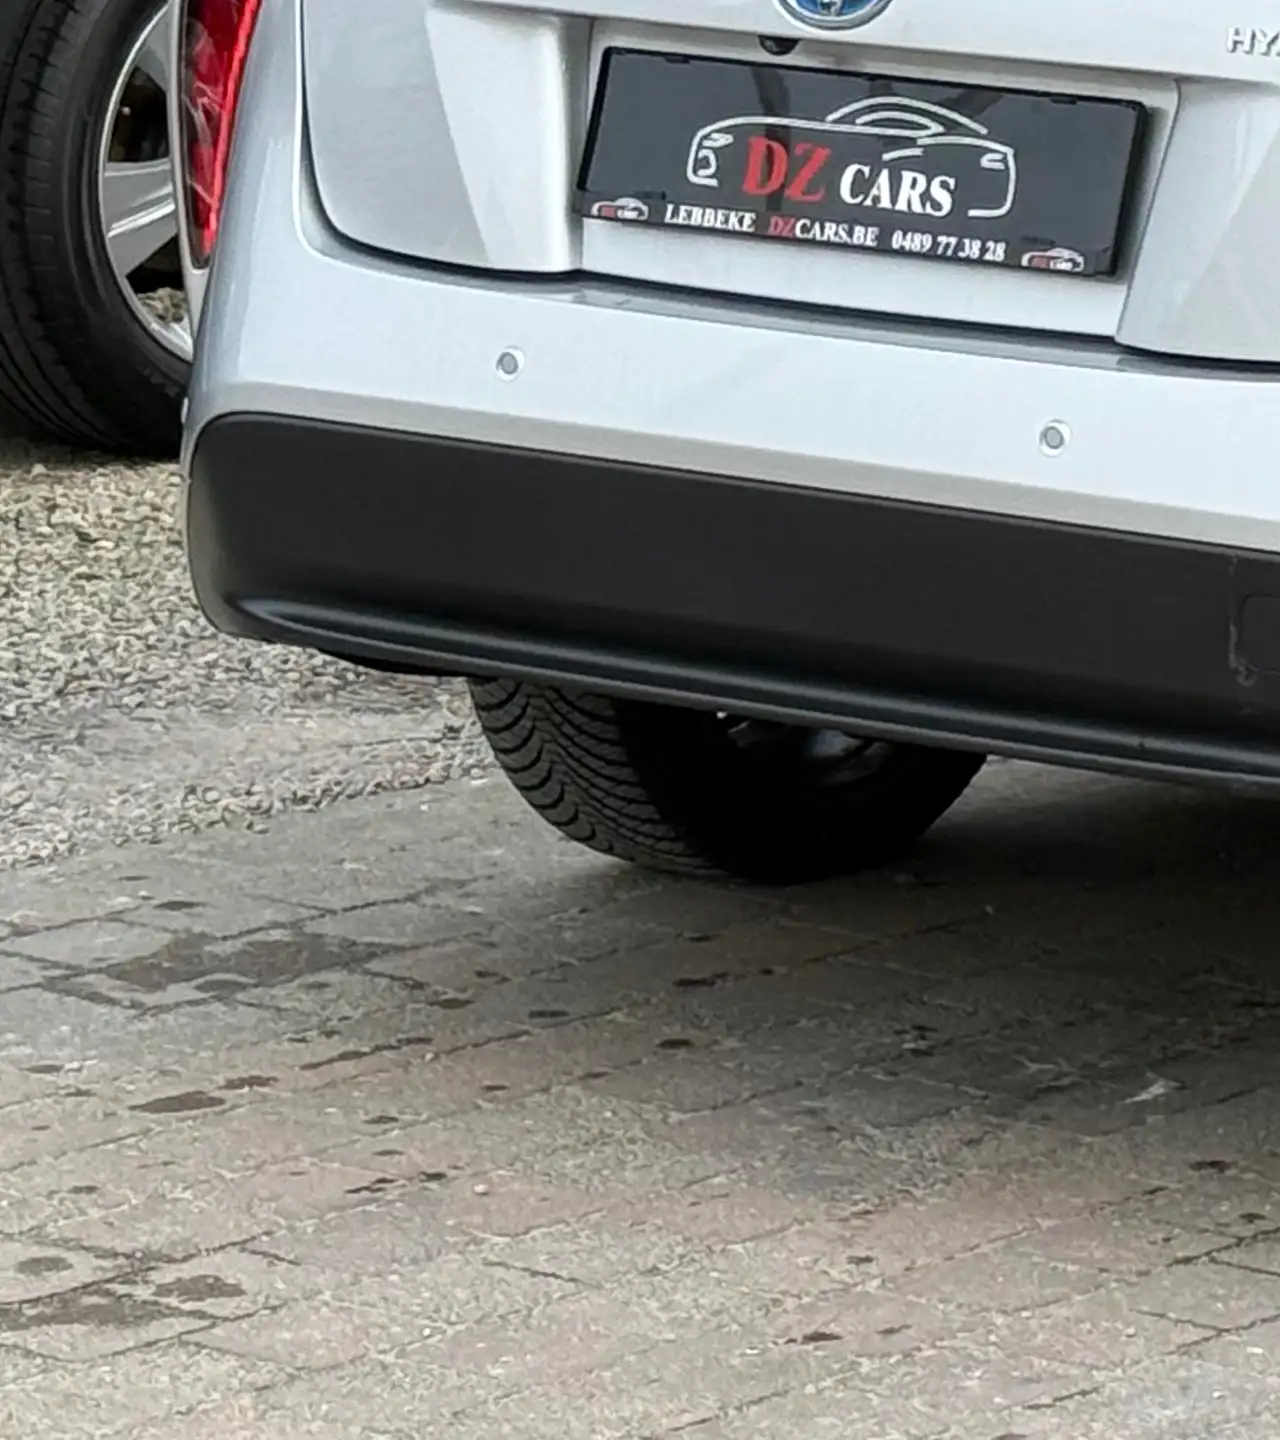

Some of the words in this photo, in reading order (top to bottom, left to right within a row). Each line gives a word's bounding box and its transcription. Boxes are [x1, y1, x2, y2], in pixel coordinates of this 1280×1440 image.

[742, 135, 831, 202] DZ
[839, 163, 956, 217] CARS
[664, 203, 756, 233] LEBBEKE
[767, 215, 879, 247] DZCARS.BE
[891, 230, 933, 253] 0489
[936, 235, 958, 256] 77
[958, 238, 982, 260] 38
[983, 240, 1007, 262] 28
